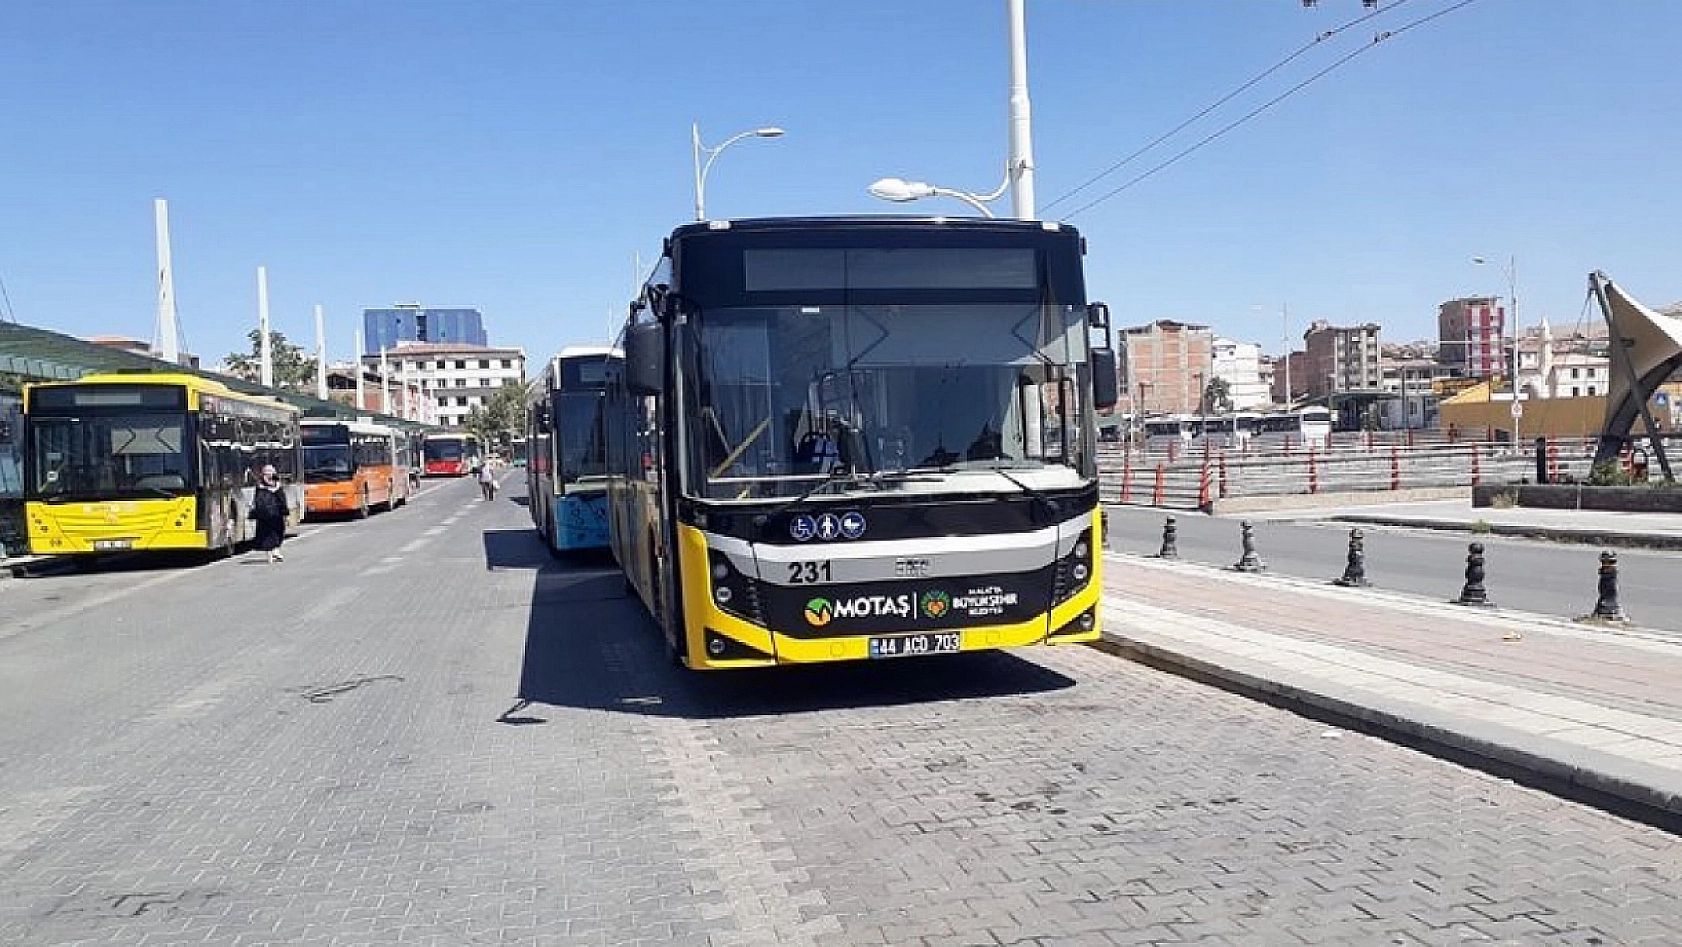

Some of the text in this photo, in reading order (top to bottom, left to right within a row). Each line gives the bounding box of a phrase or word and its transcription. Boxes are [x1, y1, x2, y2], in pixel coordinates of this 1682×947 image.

[788, 560, 831, 583] 231
[833, 595, 910, 617] MOTAŞ
[879, 638, 896, 655] 44
[935, 634, 959, 651] 703
